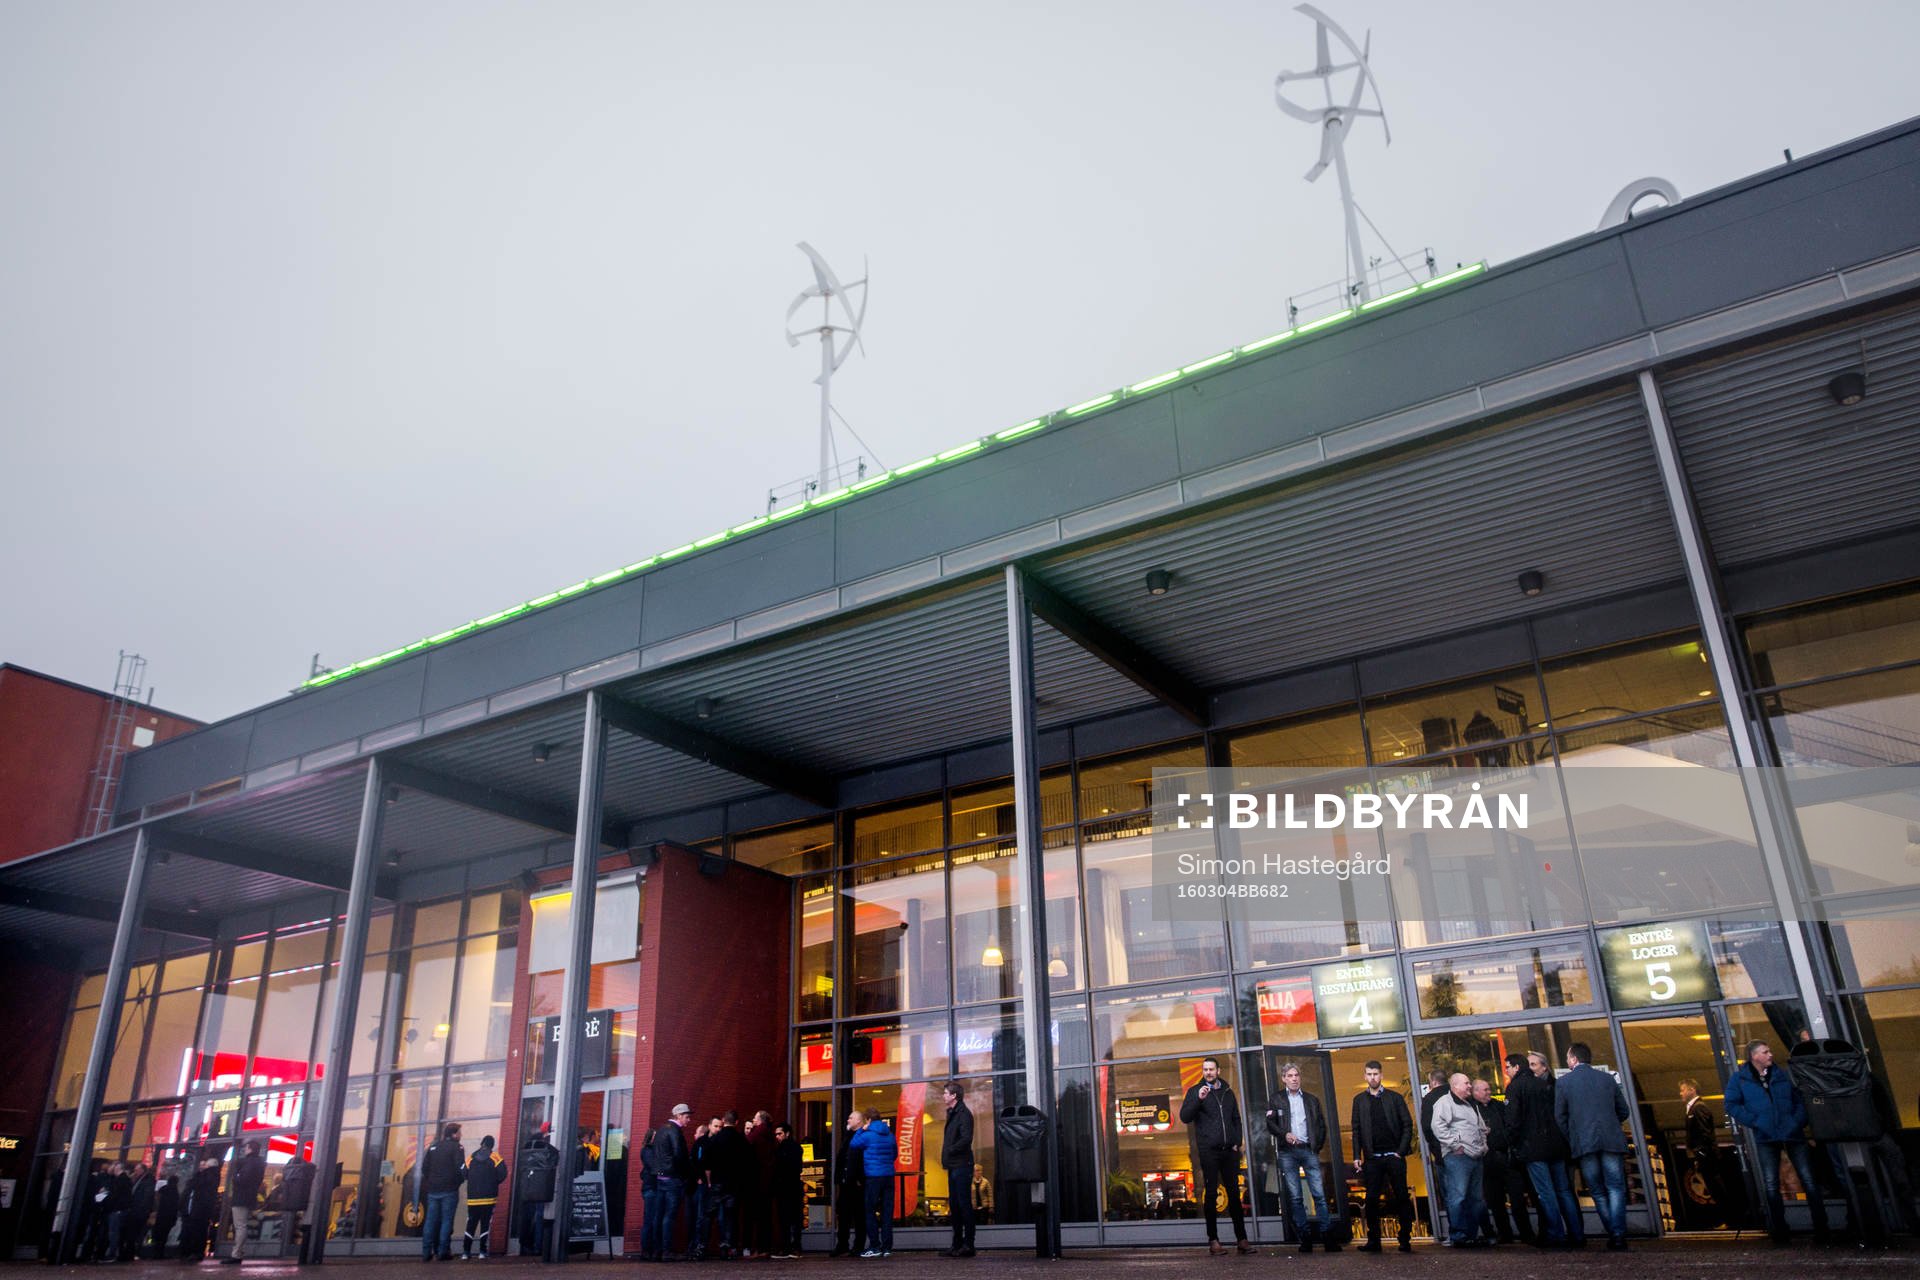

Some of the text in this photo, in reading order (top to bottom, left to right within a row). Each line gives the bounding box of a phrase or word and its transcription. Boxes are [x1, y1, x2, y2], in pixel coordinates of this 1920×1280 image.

[1631, 944, 1678, 960] LOGER
[1319, 977, 1394, 996] RESTAURANG
[1646, 962, 1677, 1000] 5
[1258, 991, 1297, 1010] ALIA
[1348, 996, 1374, 1031] 4
[218, 1114, 229, 1136] 1
[900, 1115, 917, 1165] GEVALIA
